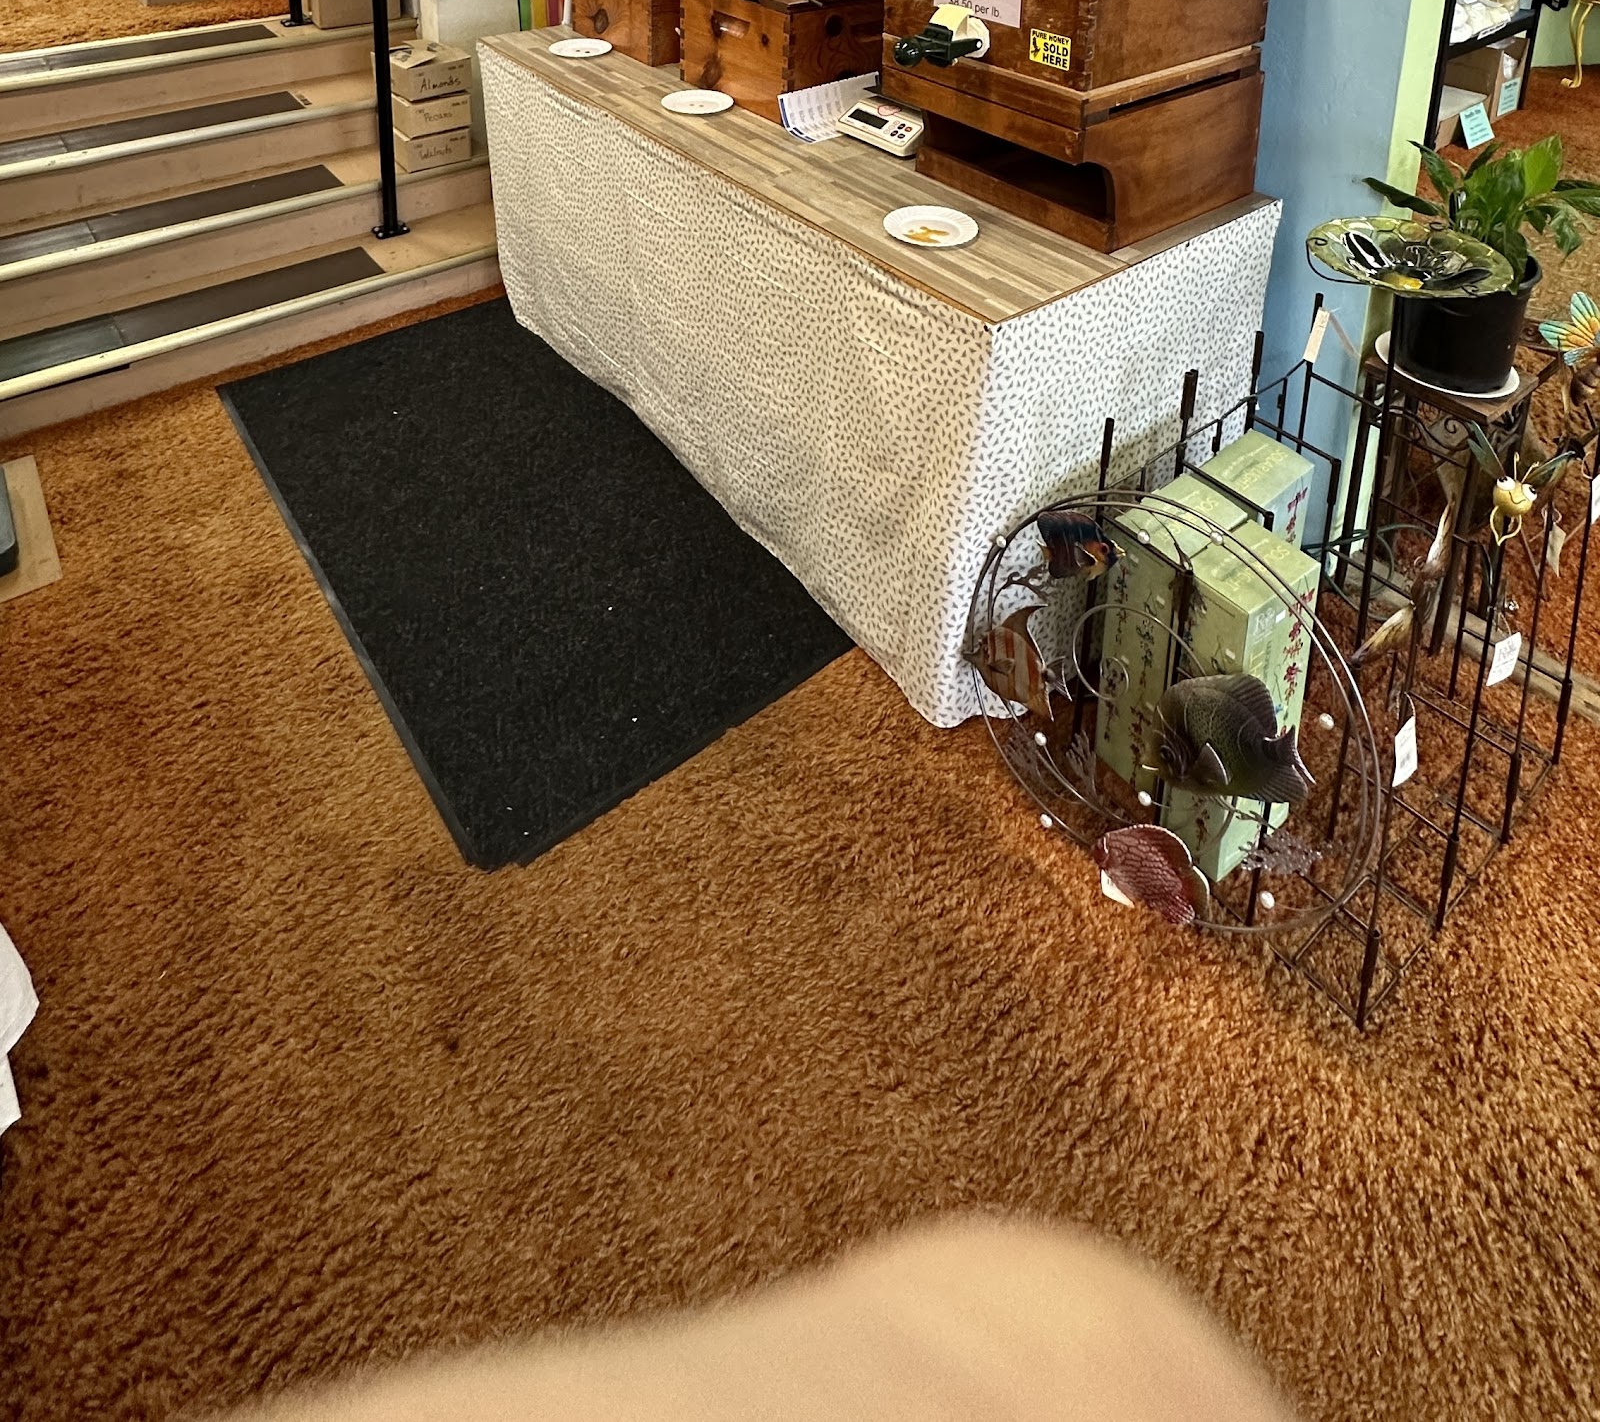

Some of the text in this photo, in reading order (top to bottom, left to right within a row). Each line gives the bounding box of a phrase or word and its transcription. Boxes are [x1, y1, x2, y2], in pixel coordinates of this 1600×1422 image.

[974, 4, 989, 15] per
[1032, 30, 1069, 45] PURE HONEY
[1043, 42, 1069, 57] SOLD
[1042, 53, 1068, 68] HERE
[420, 76, 462, 93] Almonds
